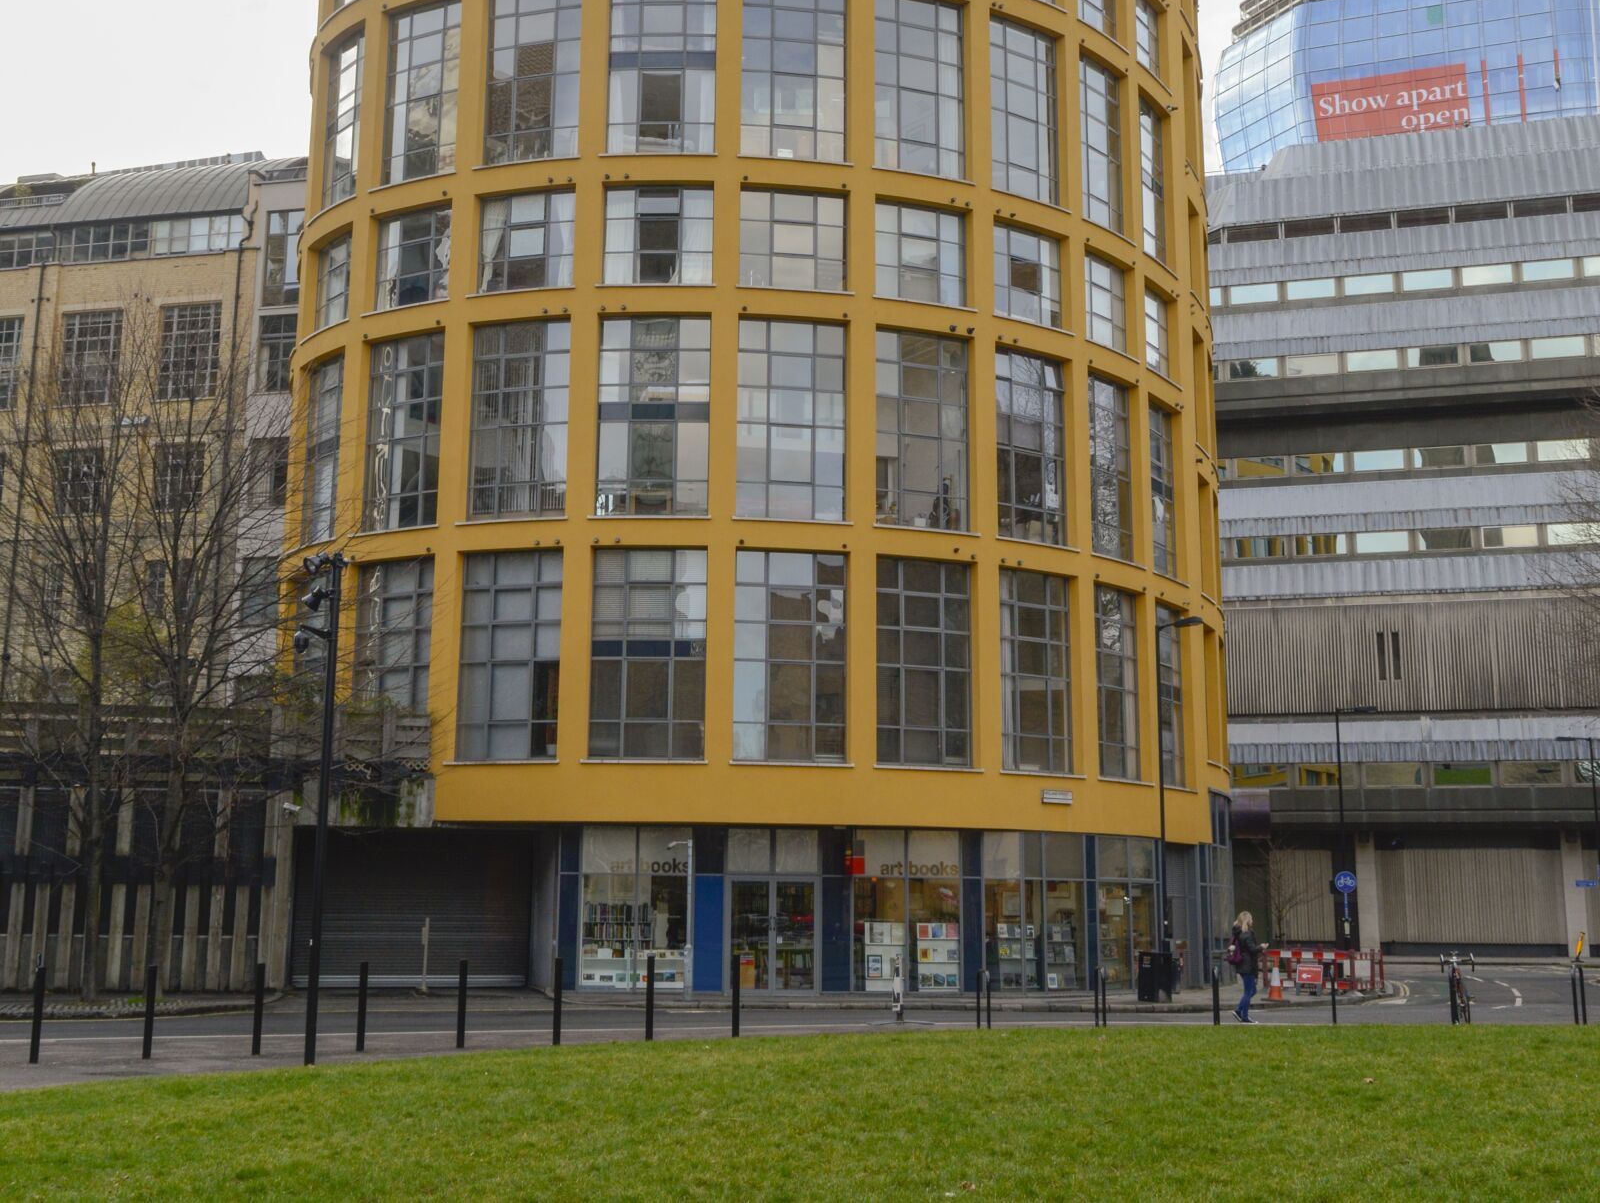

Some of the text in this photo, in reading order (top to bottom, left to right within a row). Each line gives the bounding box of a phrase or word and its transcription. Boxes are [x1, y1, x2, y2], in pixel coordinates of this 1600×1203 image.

[1318, 80, 1467, 117] Show apart
[1401, 107, 1469, 132] open
[880, 861, 959, 876] art books
